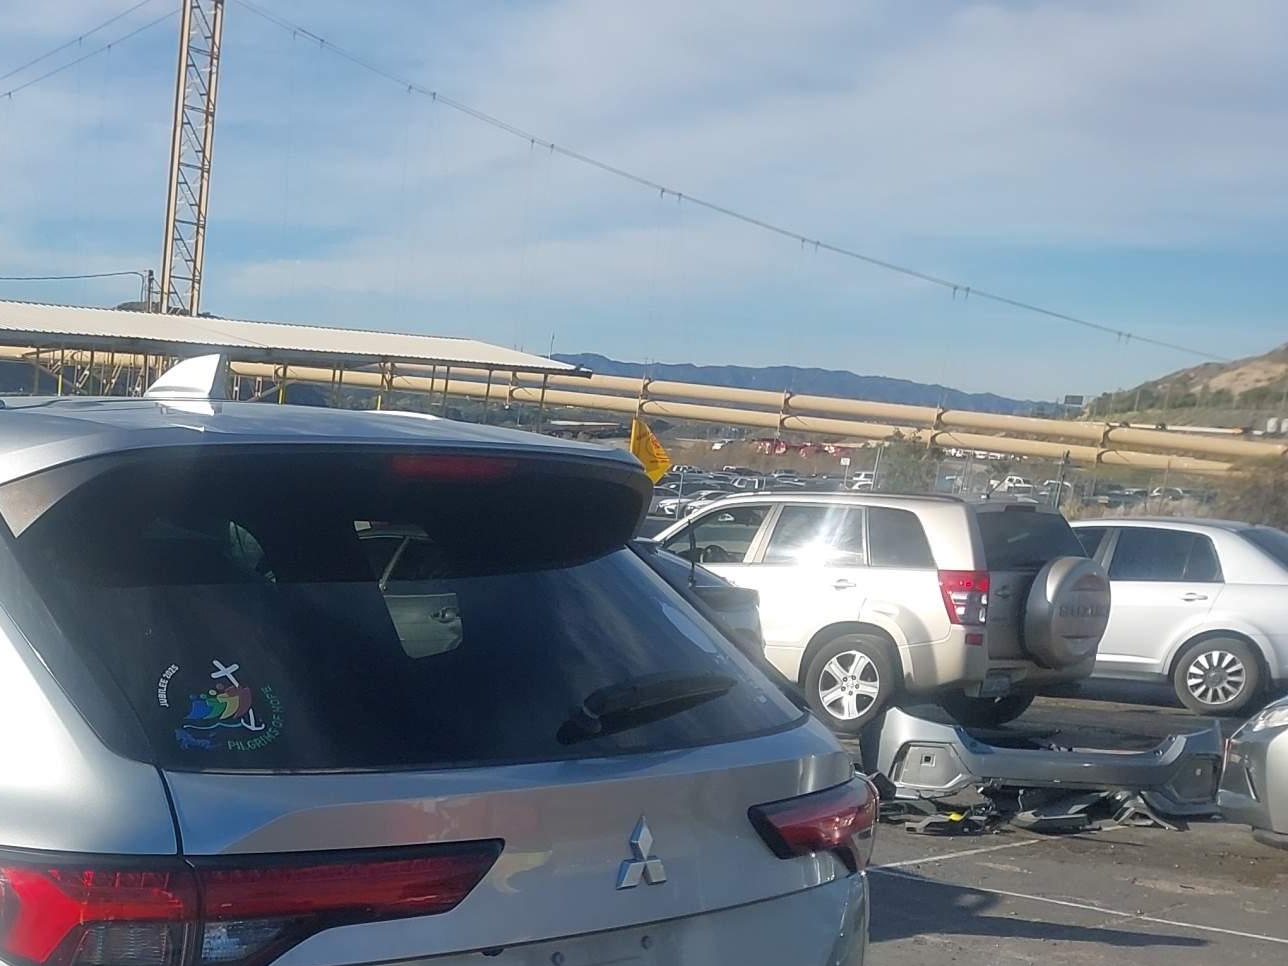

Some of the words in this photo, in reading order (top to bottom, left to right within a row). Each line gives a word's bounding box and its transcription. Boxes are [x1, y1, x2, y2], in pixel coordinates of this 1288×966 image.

[162, 663, 179, 681] 2025
[158, 677, 169, 708] JUBILEE
[227, 727, 280, 752] PILGRIMS
